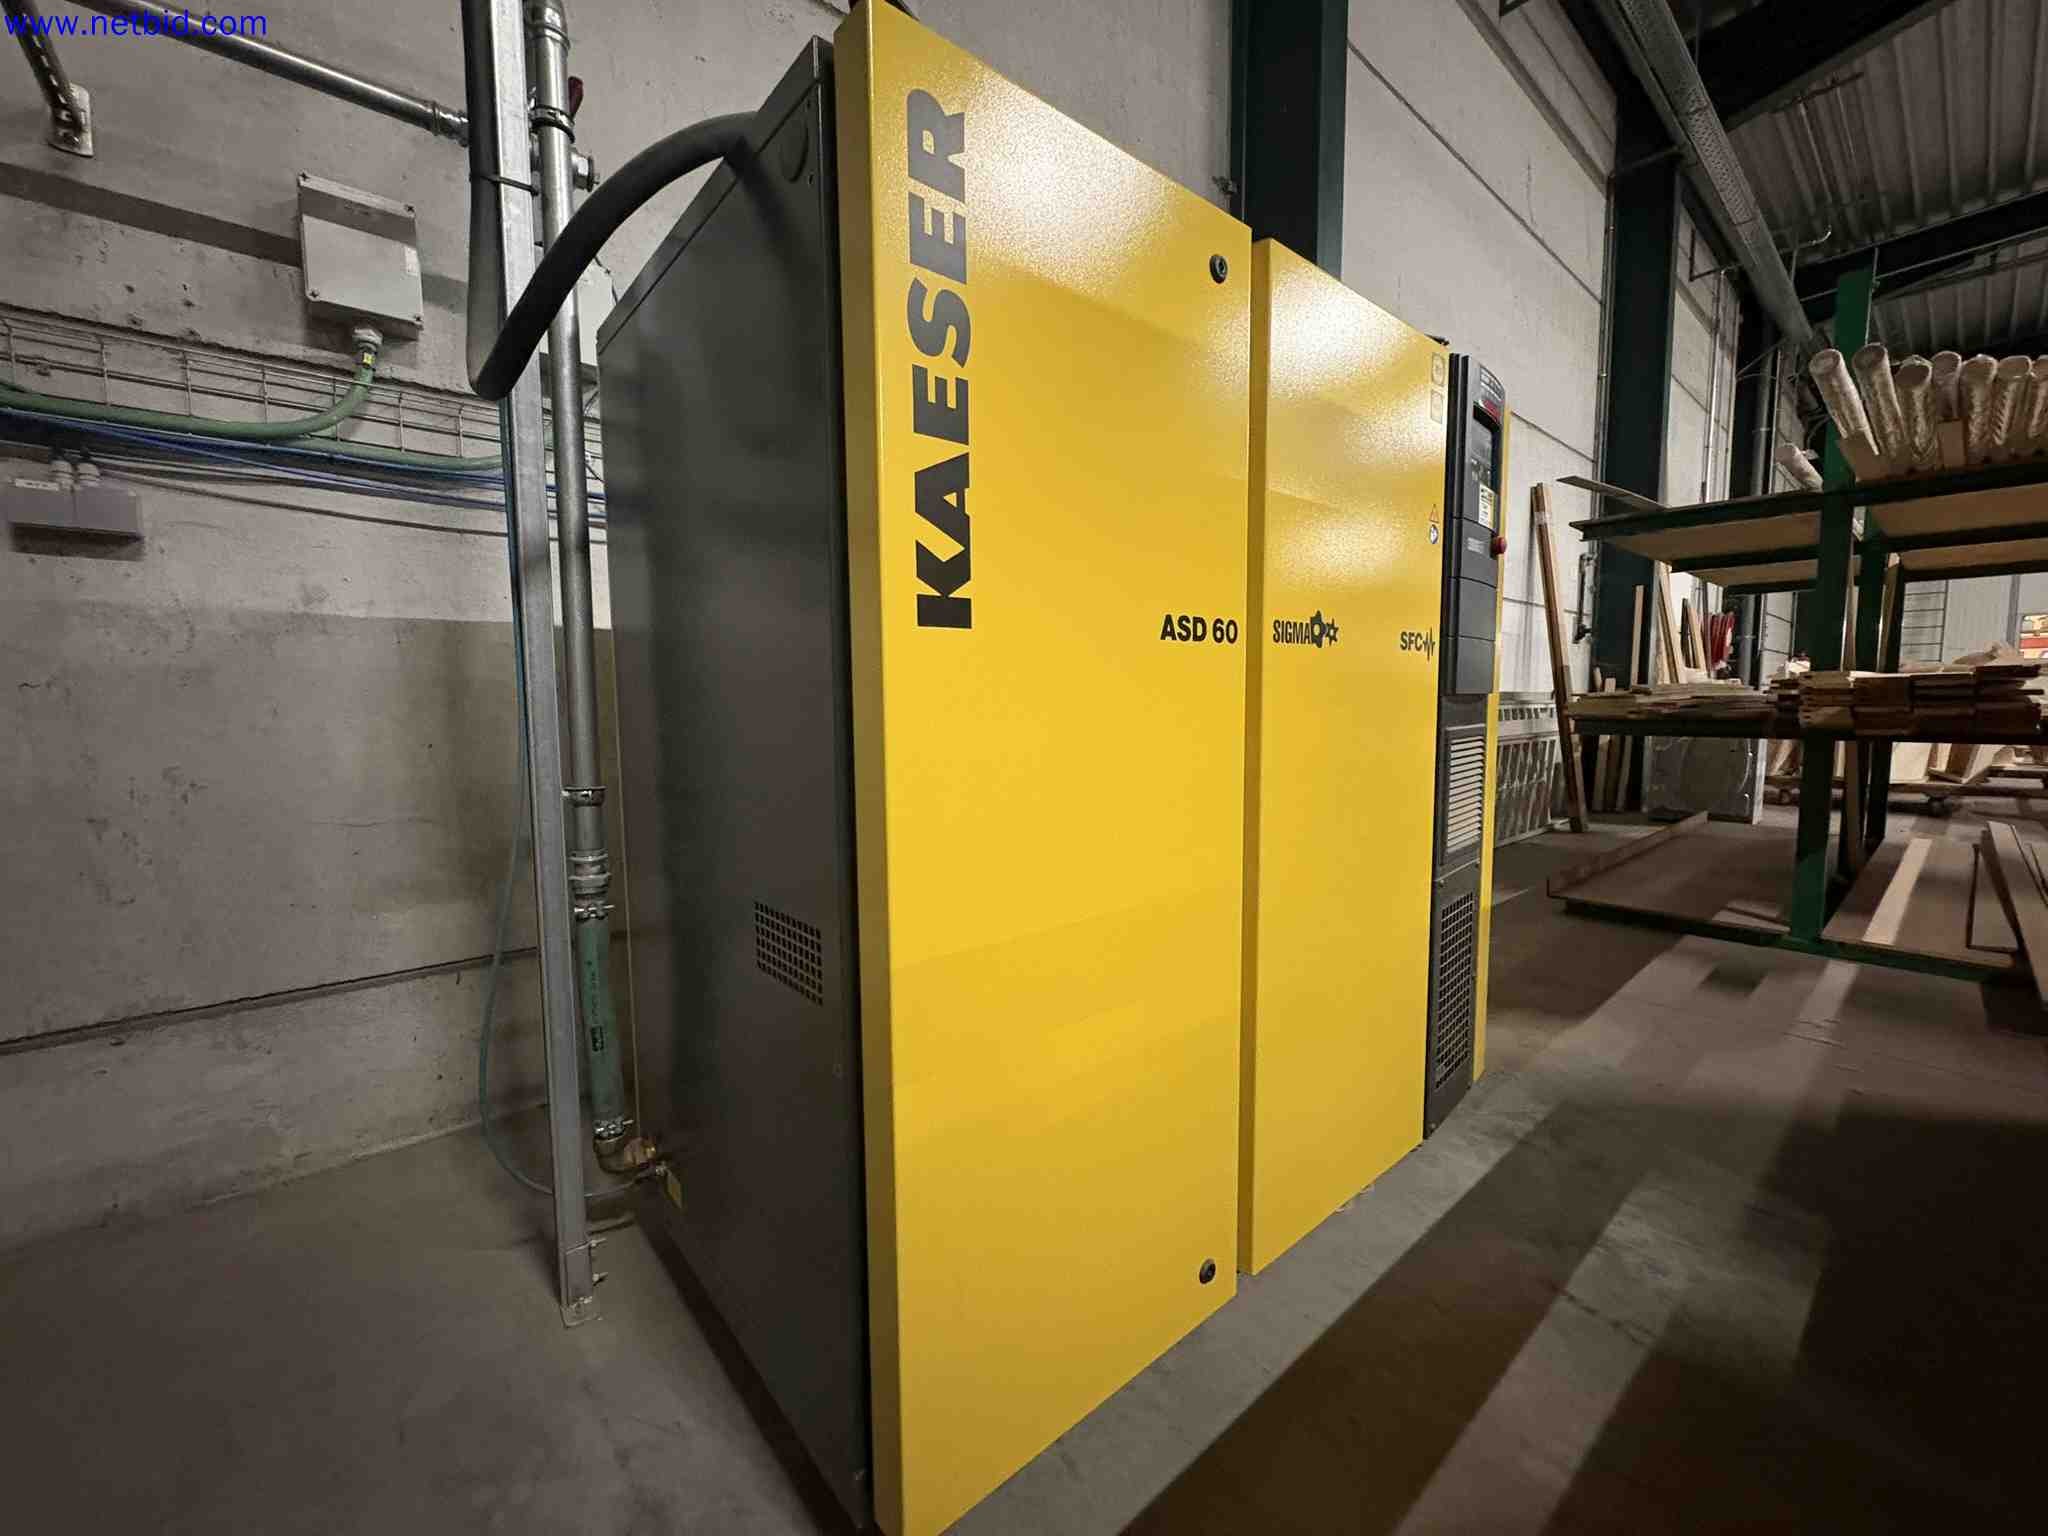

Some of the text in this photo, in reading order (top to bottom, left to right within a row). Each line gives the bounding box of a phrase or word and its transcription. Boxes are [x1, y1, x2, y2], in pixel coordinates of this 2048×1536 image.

[907, 88, 972, 629] KAESER
[1160, 614, 1238, 644] ASD 60
[1272, 619, 1311, 645] SIGMA
[1400, 631, 1423, 651] SFC
